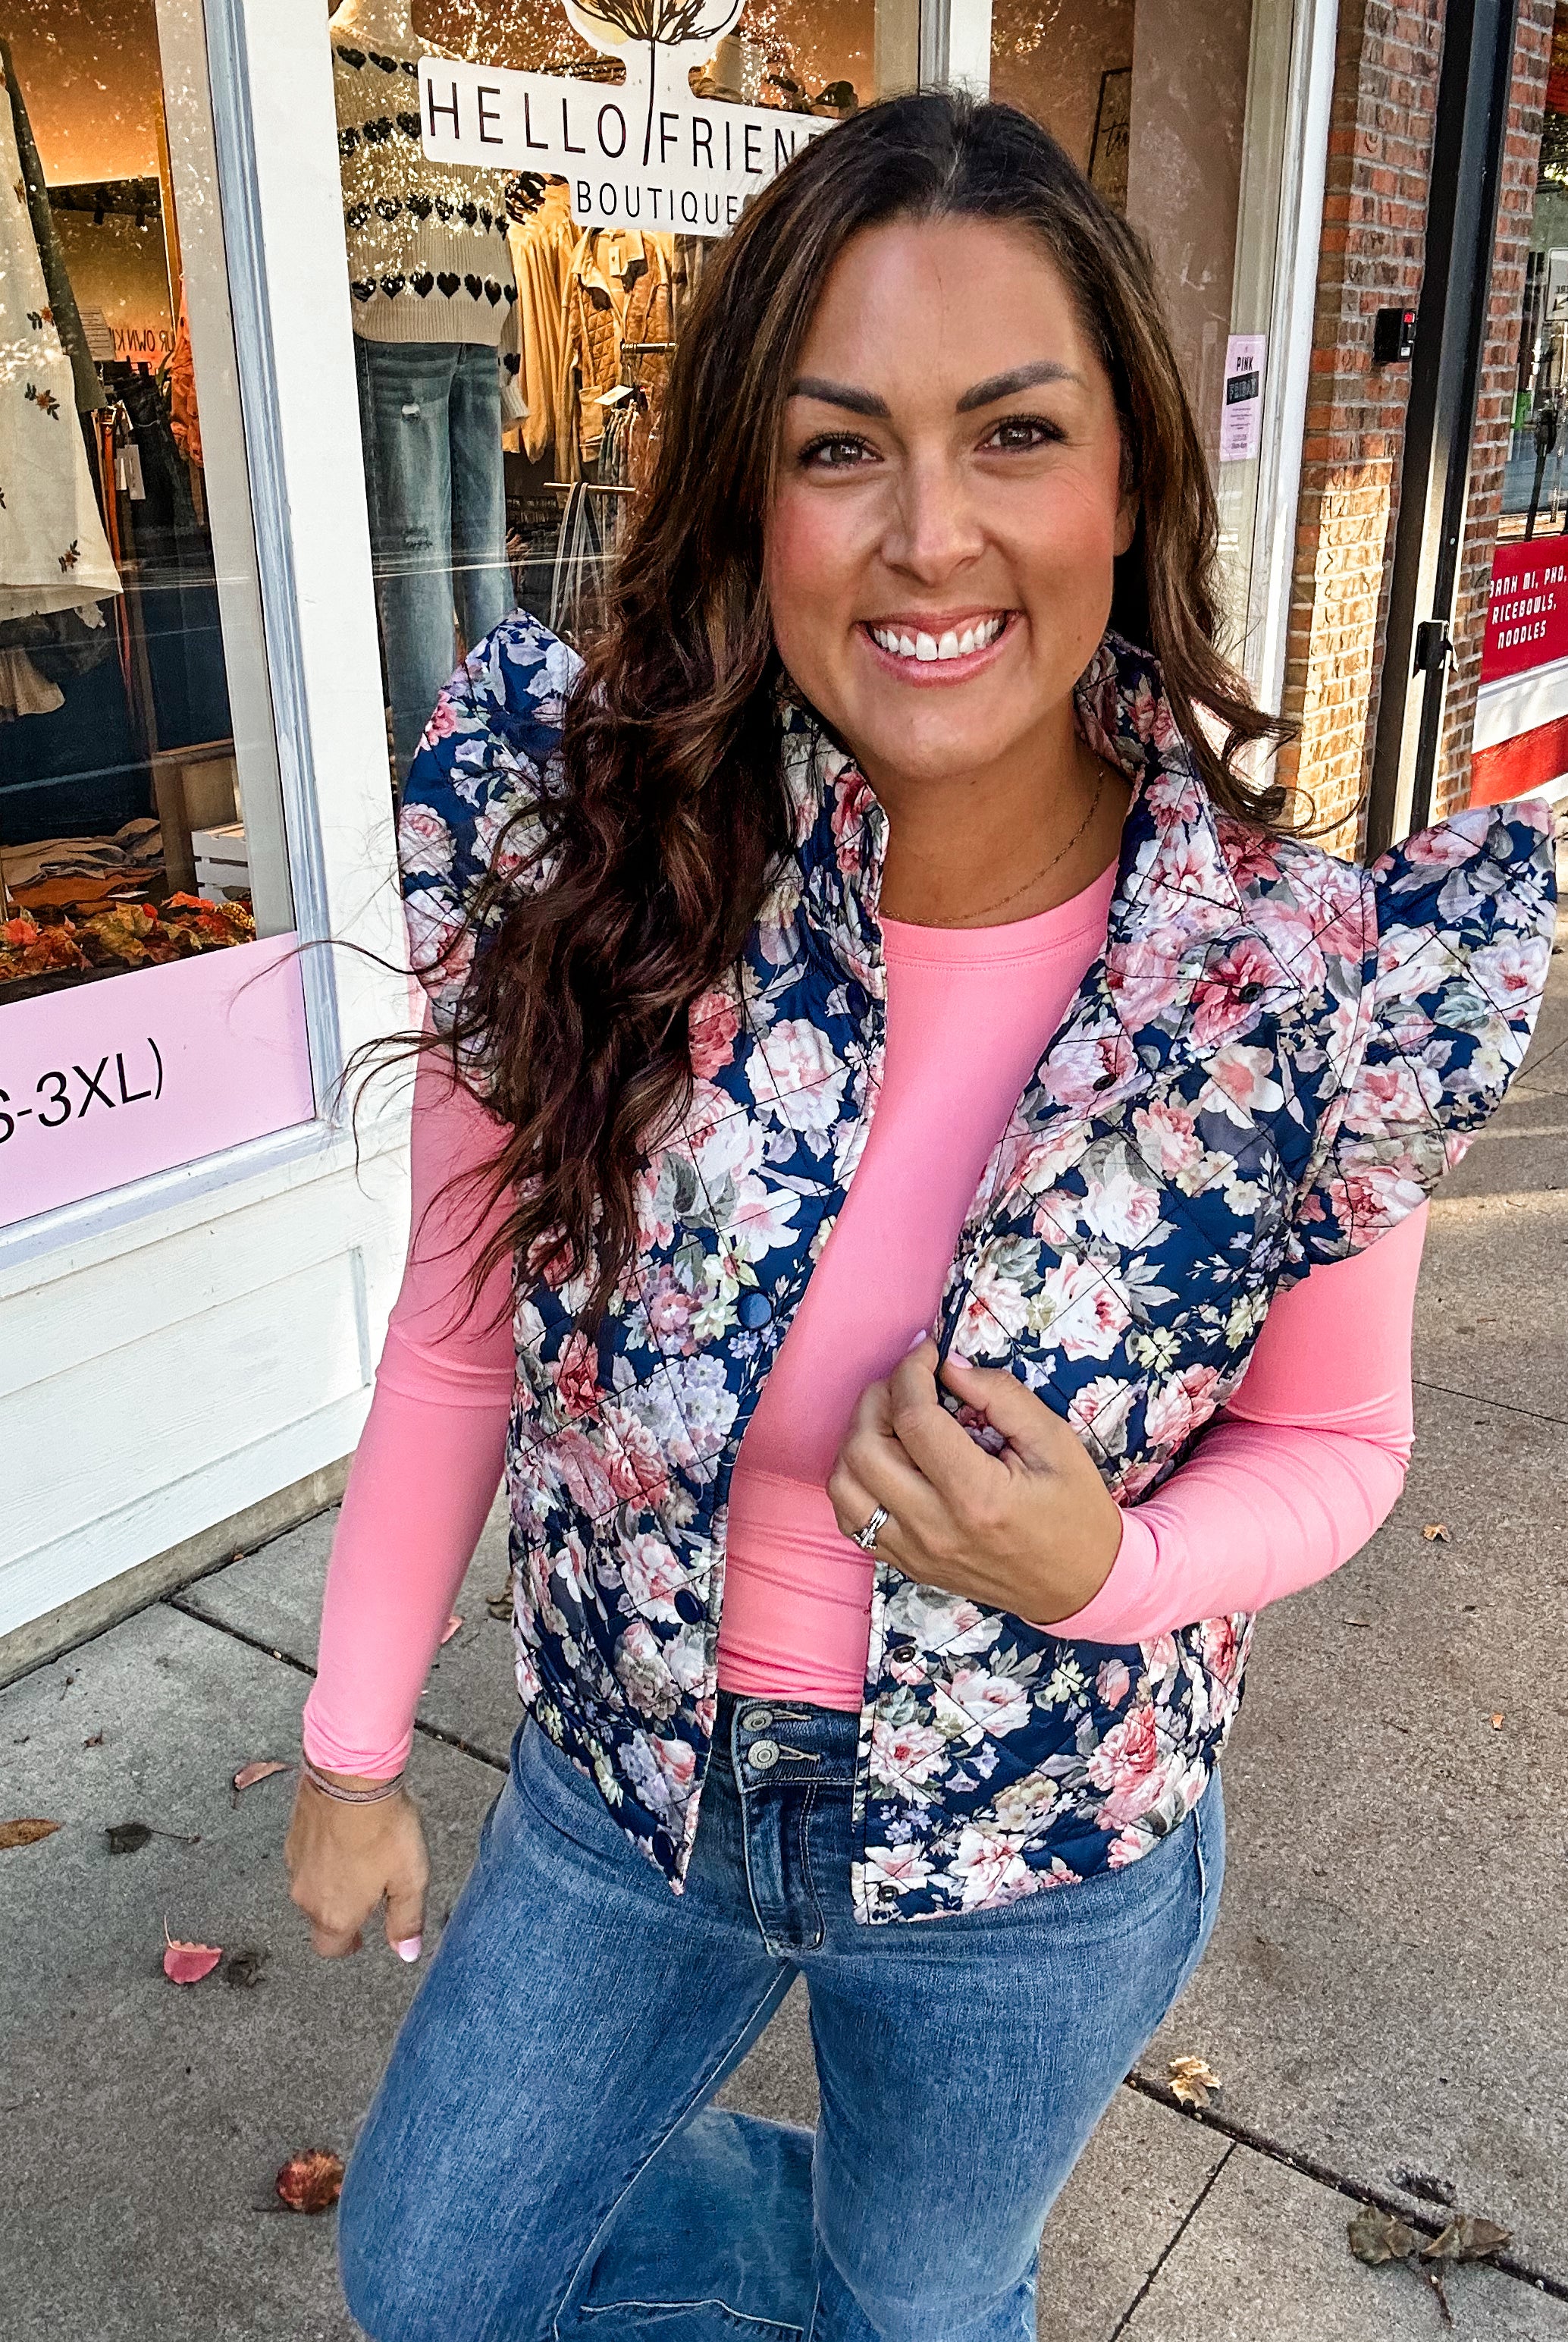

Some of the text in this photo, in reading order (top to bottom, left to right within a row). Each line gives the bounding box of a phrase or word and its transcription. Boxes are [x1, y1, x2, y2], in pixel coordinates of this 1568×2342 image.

[427, 79, 820, 174] HELLO FRIEN
[577, 180, 738, 225] BOUTIQUE
[1237, 356, 1254, 372] PINK
[1544, 565, 1567, 586] PHO,
[1491, 592, 1557, 625] RICEBOWLS,
[1497, 620, 1547, 650] NOODLES
